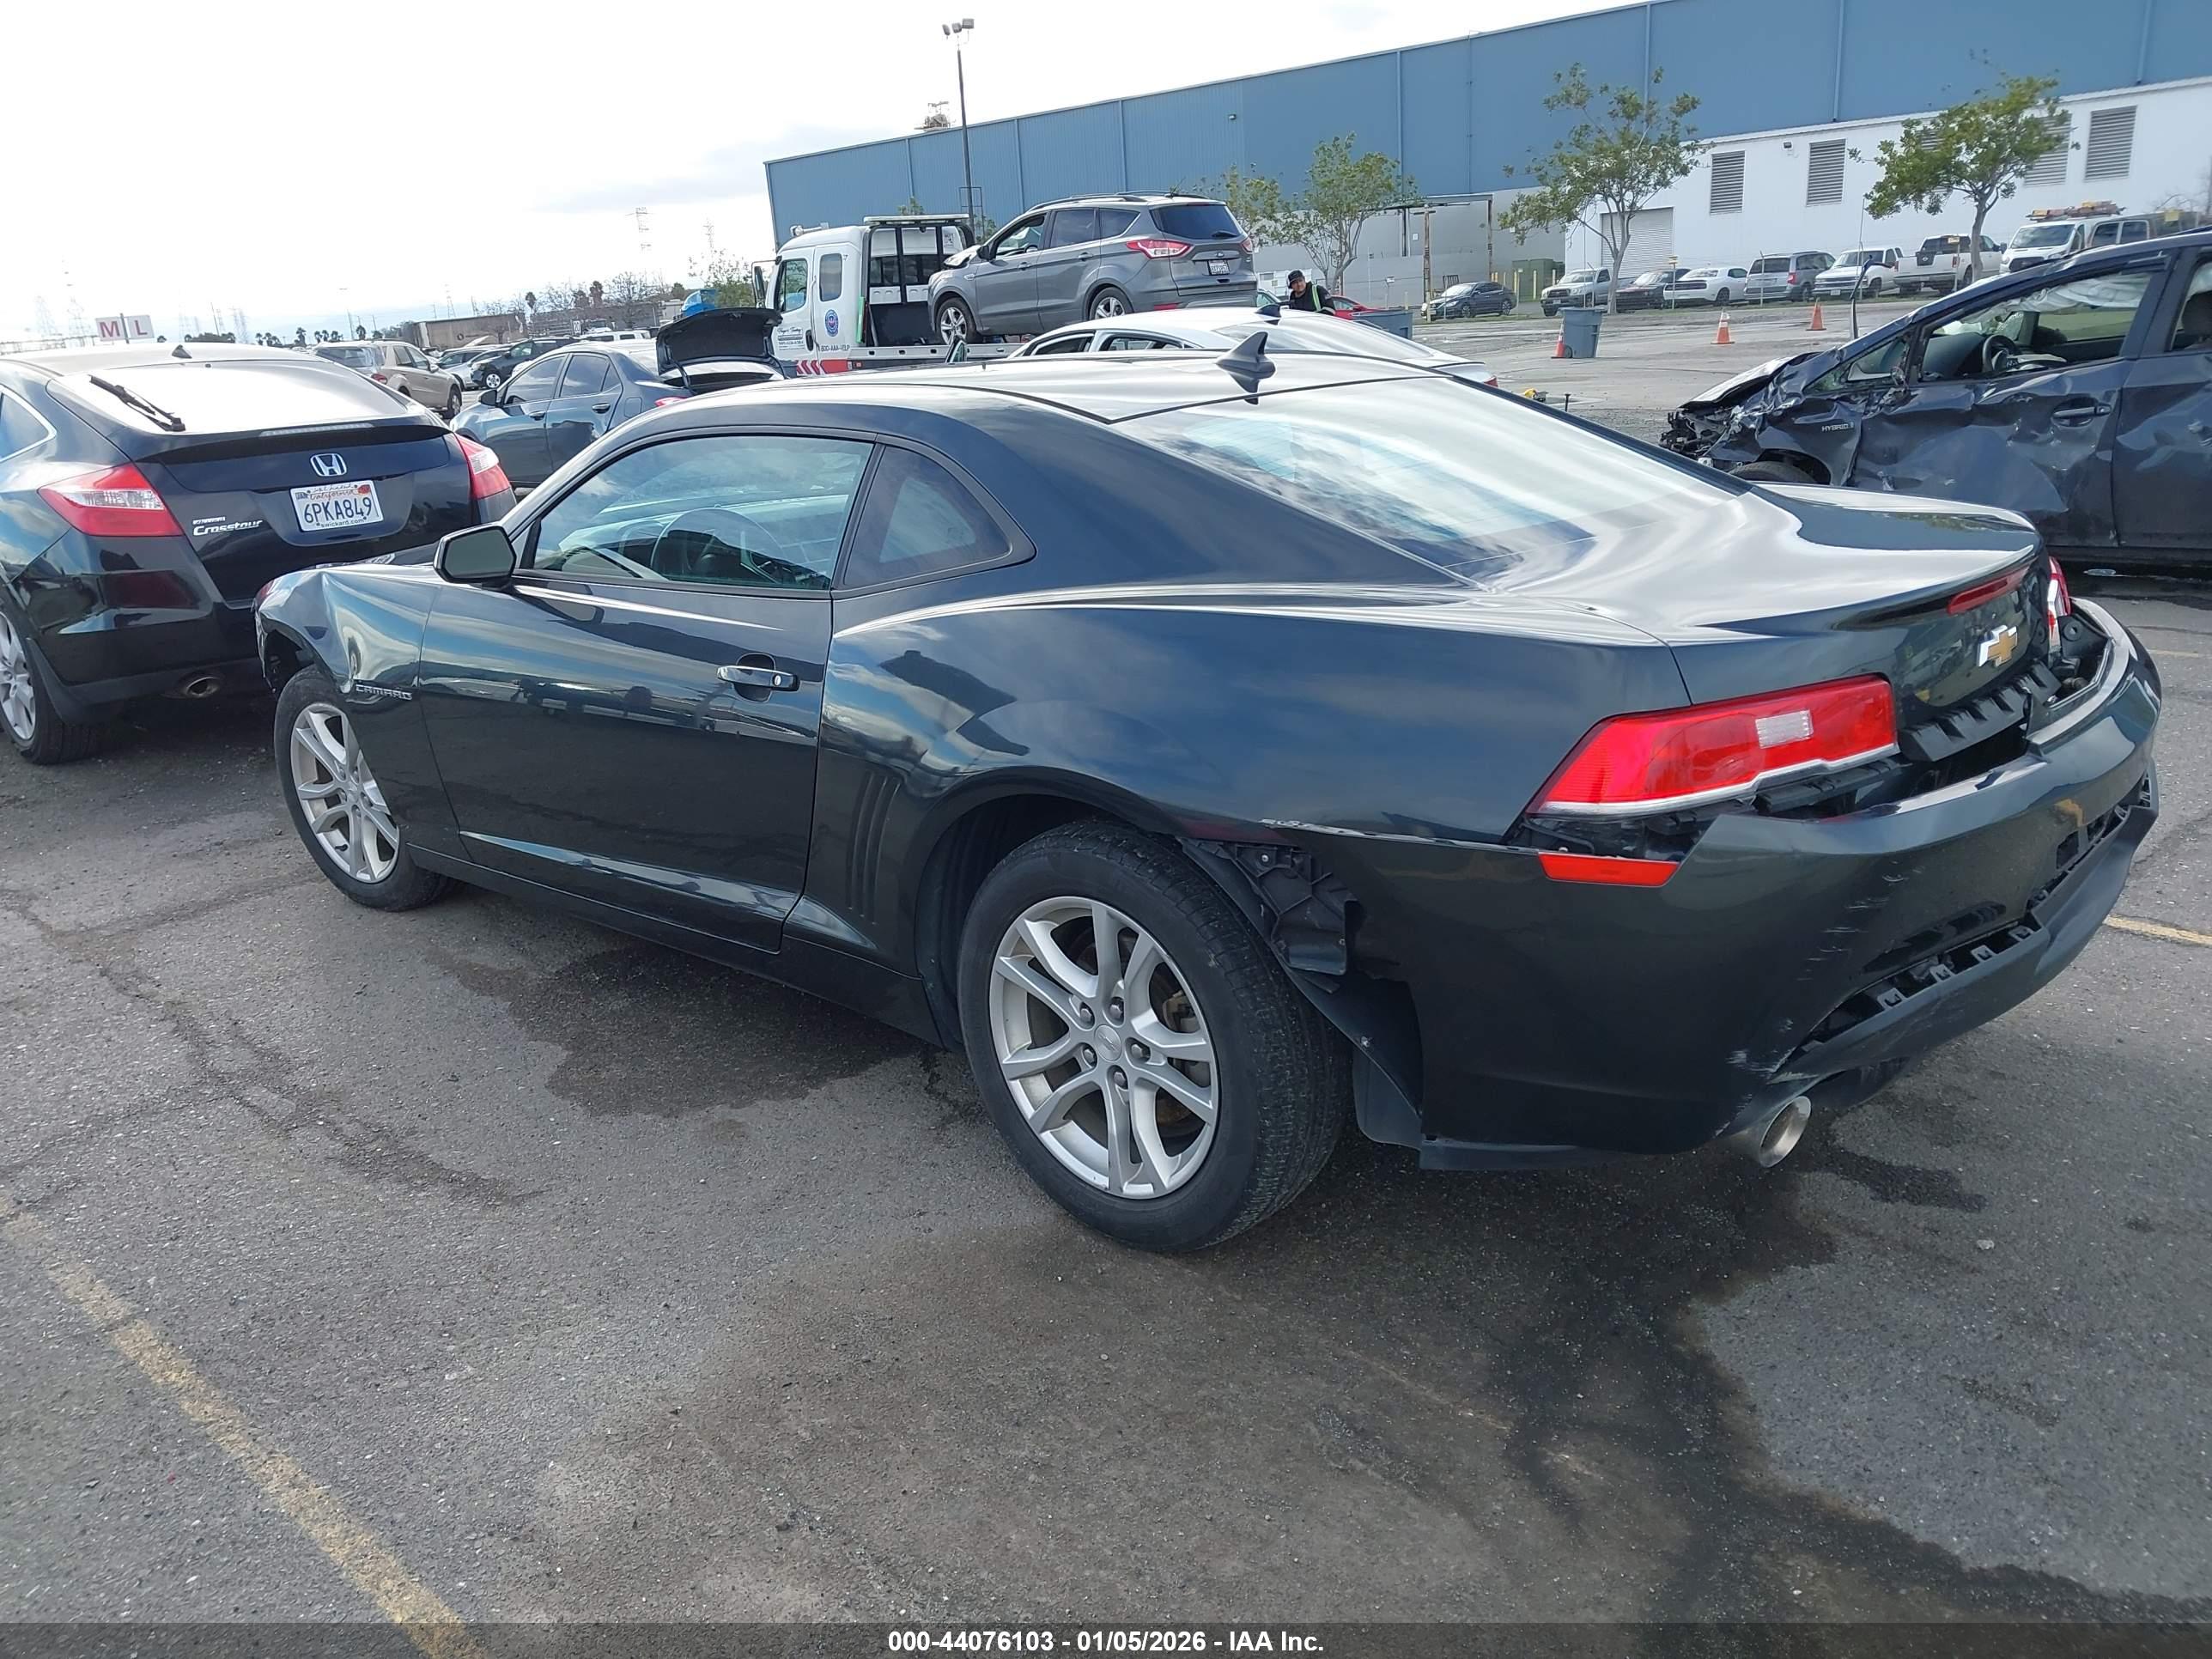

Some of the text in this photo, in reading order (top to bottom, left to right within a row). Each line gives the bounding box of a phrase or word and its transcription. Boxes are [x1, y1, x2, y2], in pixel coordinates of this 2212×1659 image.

[100, 320, 120, 337] M
[134, 319, 148, 336] L
[304, 496, 372, 524] 6PKA849
[193, 520, 264, 536] Crosstour
[320, 518, 365, 528] swickard.com
[355, 684, 413, 701] CAMARO
